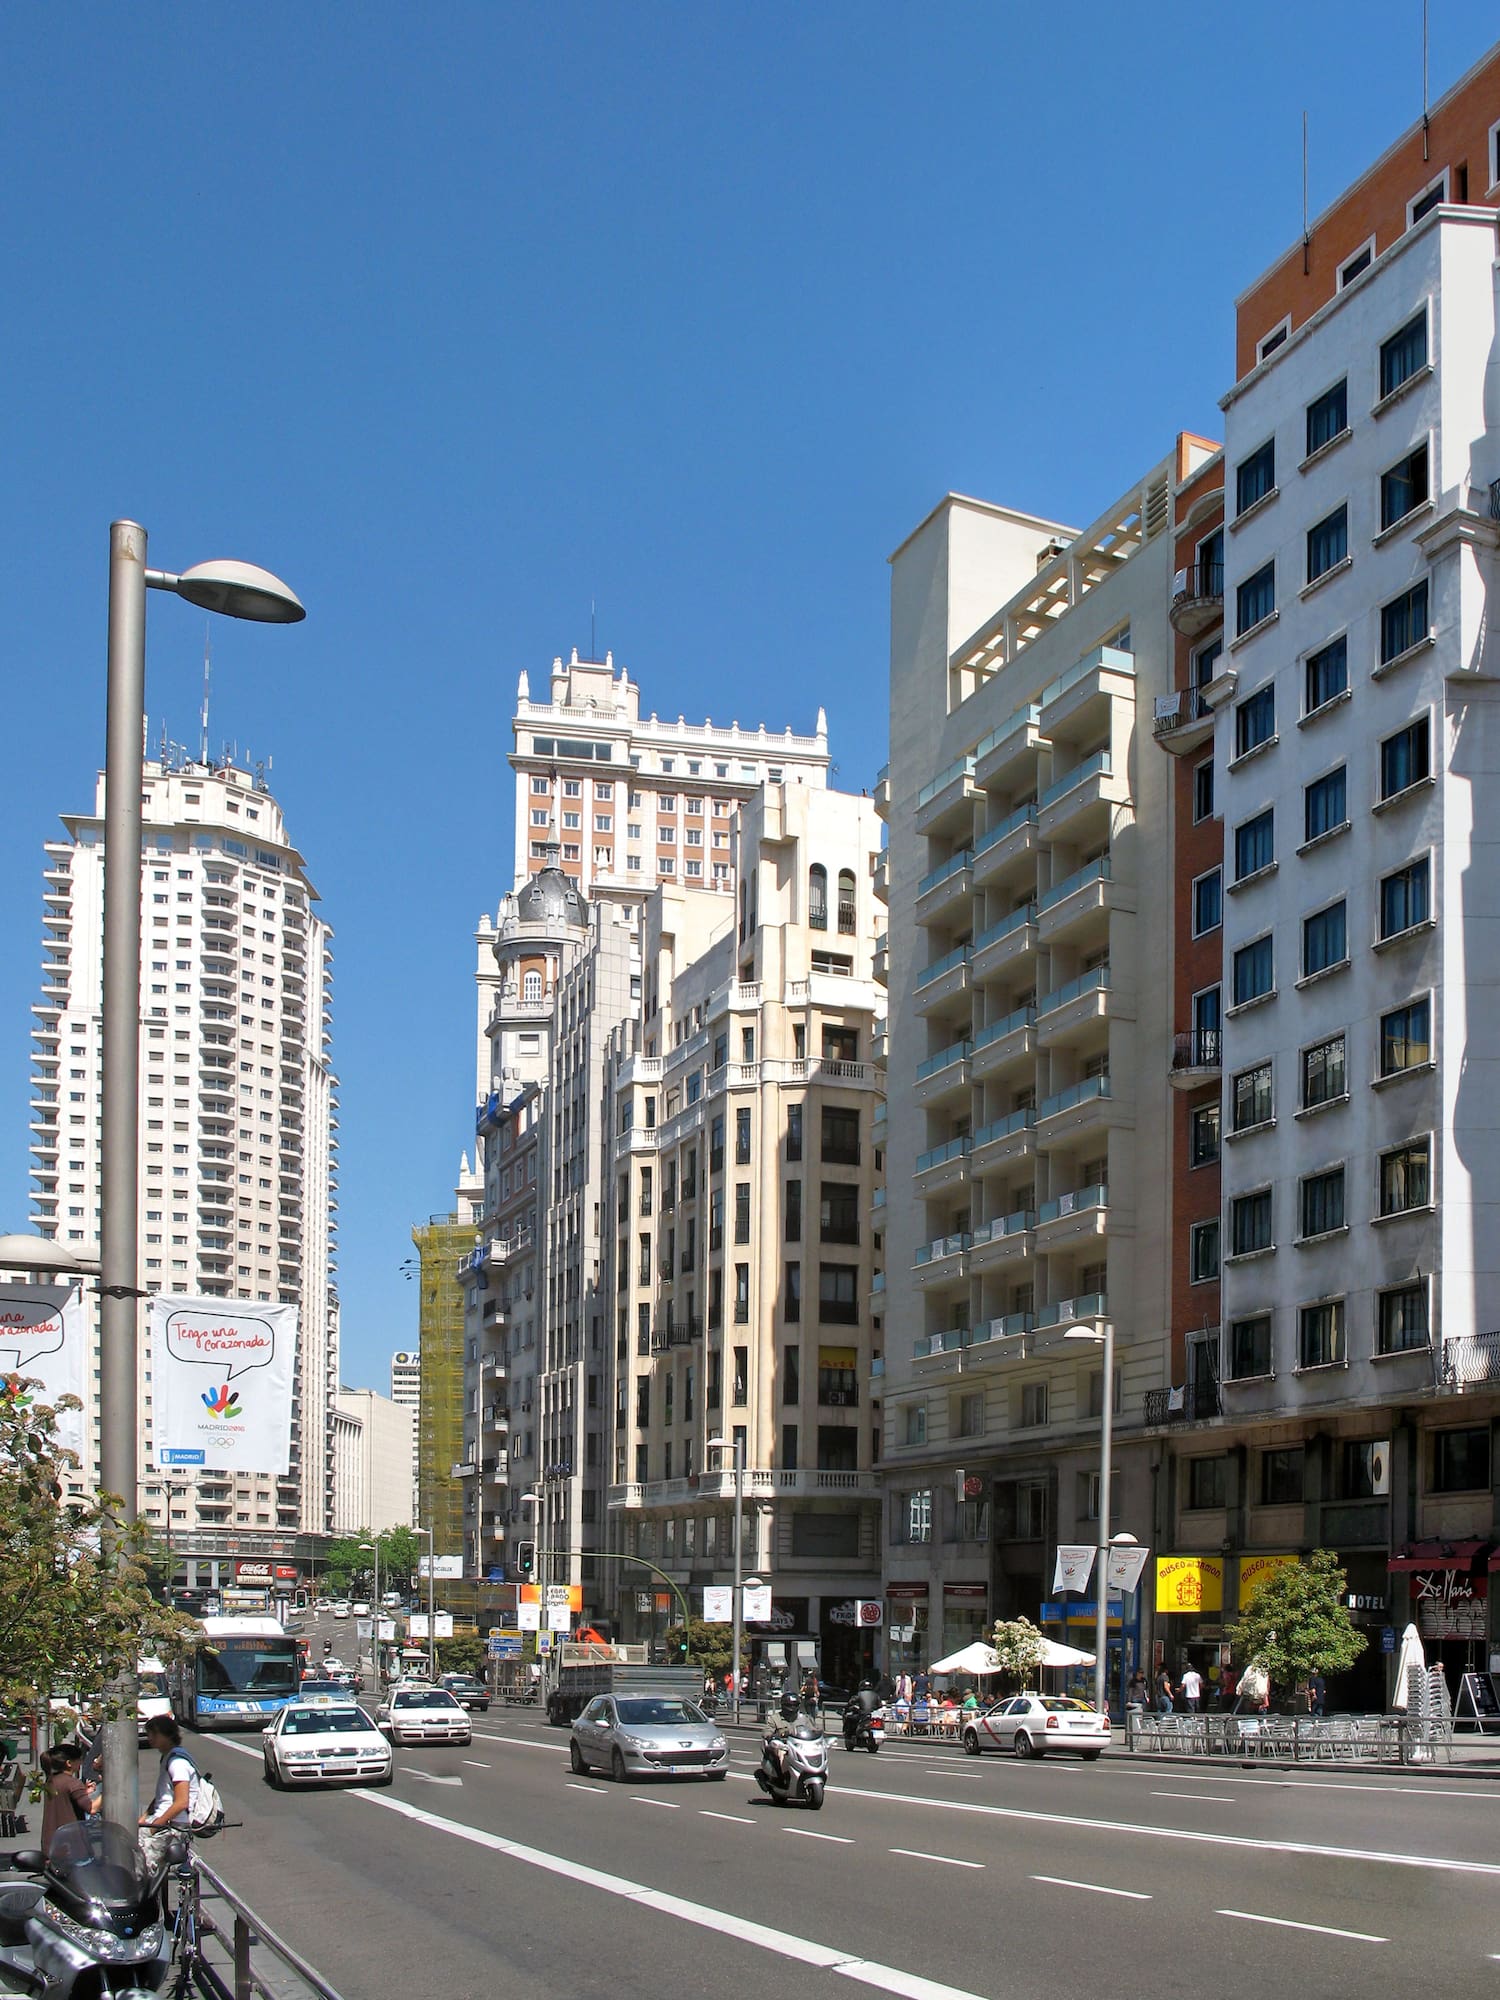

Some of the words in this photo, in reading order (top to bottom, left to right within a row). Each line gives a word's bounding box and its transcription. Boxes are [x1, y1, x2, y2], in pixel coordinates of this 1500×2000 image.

[172, 1323, 208, 1348] Tengo
[212, 1328, 238, 1337] una
[205, 1334, 270, 1351] corazonada
[1159, 1560, 1185, 1578] MUSEO
[1241, 1559, 1265, 1583] MUSEO
[1348, 1594, 1385, 1610] HOTEL
